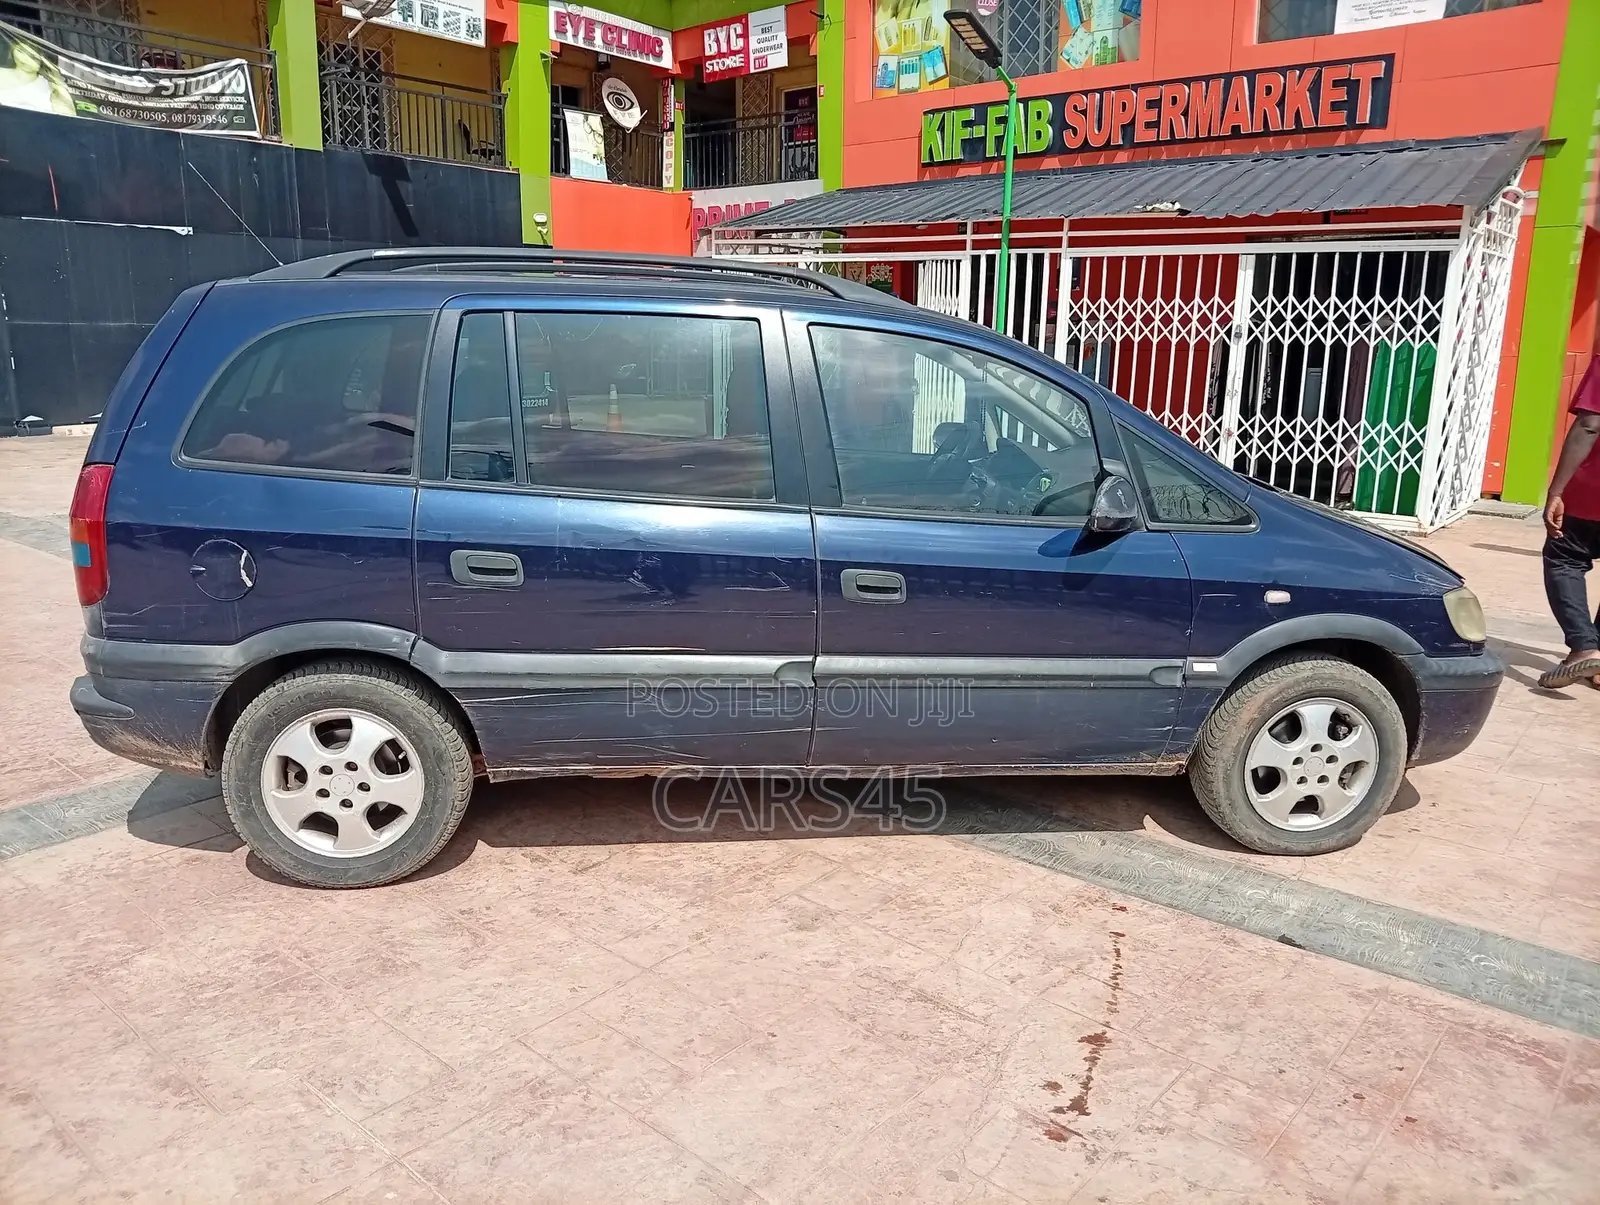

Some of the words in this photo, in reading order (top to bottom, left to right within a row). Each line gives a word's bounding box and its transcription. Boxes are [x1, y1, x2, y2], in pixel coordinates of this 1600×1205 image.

[554, 10, 597, 41] EYE
[602, 23, 664, 57] CLINIC
[703, 22, 744, 57] BYC
[756, 34, 778, 45] QUALITY
[760, 26, 773, 34] BEST
[751, 43, 783, 55] UNDERWEAR
[705, 53, 745, 73] STORE
[99, 104, 170, 124] 08168730505,
[920, 99, 1053, 164] KIF-FAB
[1062, 60, 1386, 150] SUPERMARKET
[692, 201, 770, 241] PRIM
